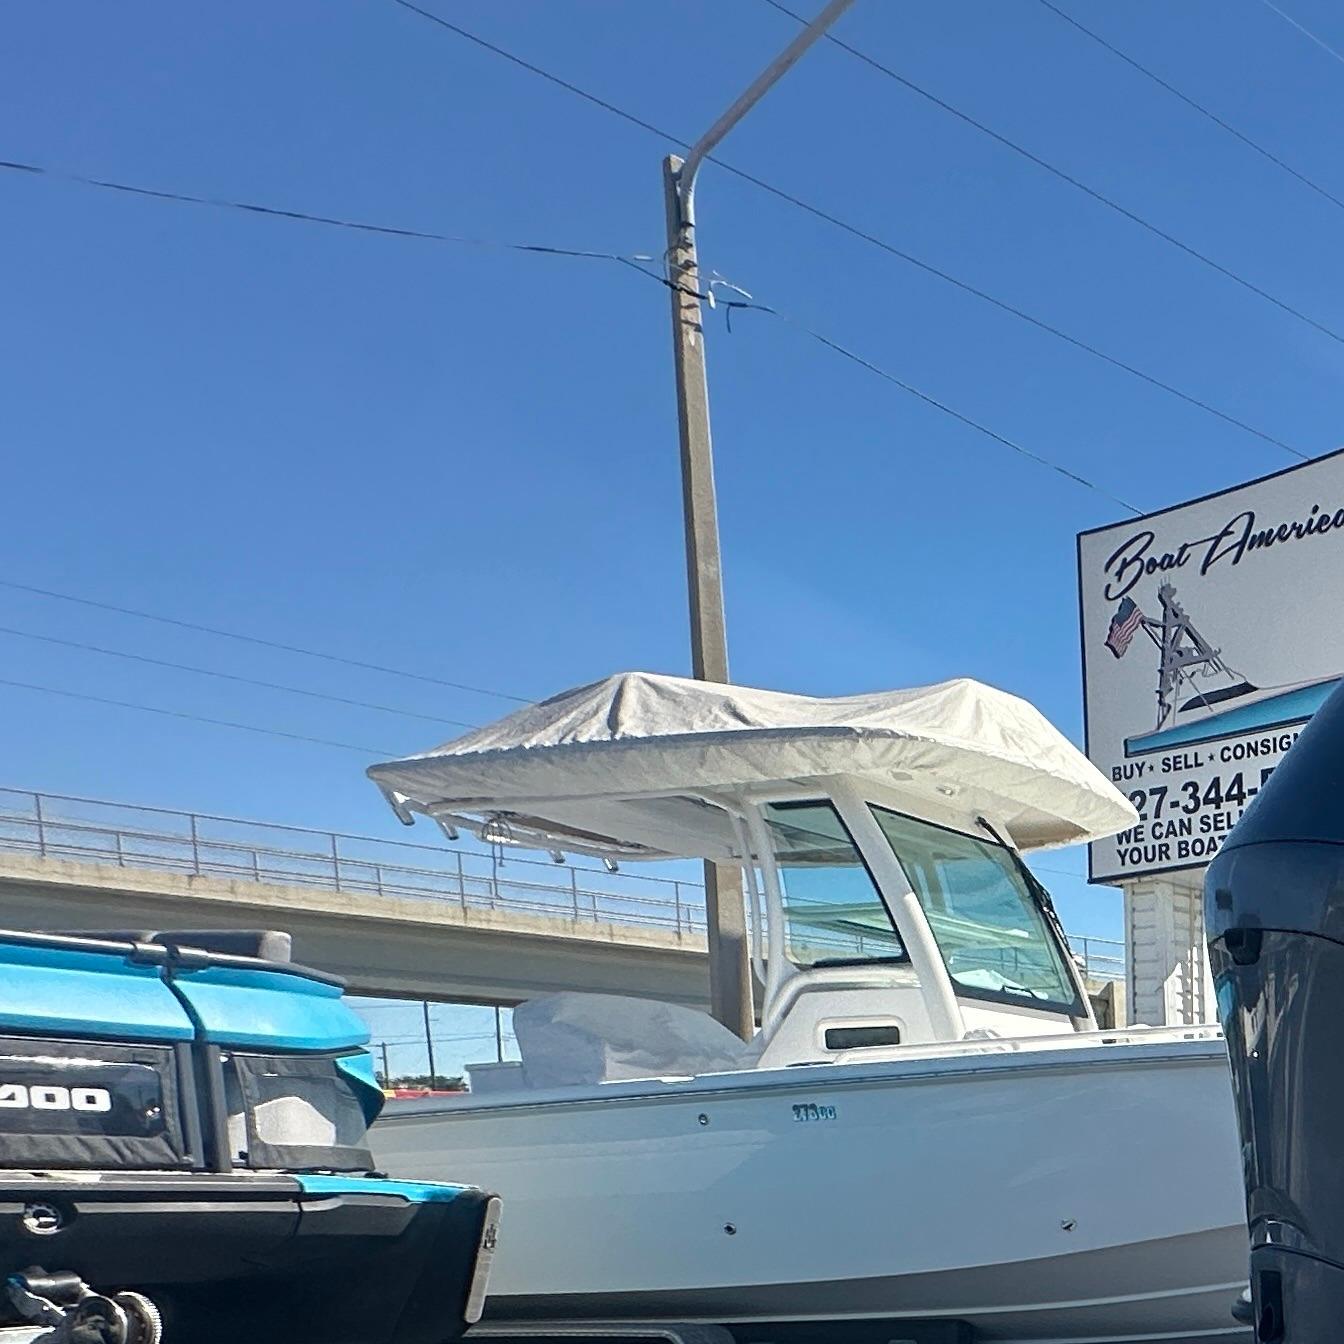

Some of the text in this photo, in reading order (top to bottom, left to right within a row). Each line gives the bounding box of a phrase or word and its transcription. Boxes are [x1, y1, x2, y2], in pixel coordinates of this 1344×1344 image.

[1104, 531, 1215, 601] Boat
[1112, 761, 1146, 782] BUY
[1161, 752, 1204, 773] SELL
[1124, 766, 1277, 823] 27-344-
[1151, 817, 1193, 841] CAN
[1116, 843, 1172, 867] YOUR
